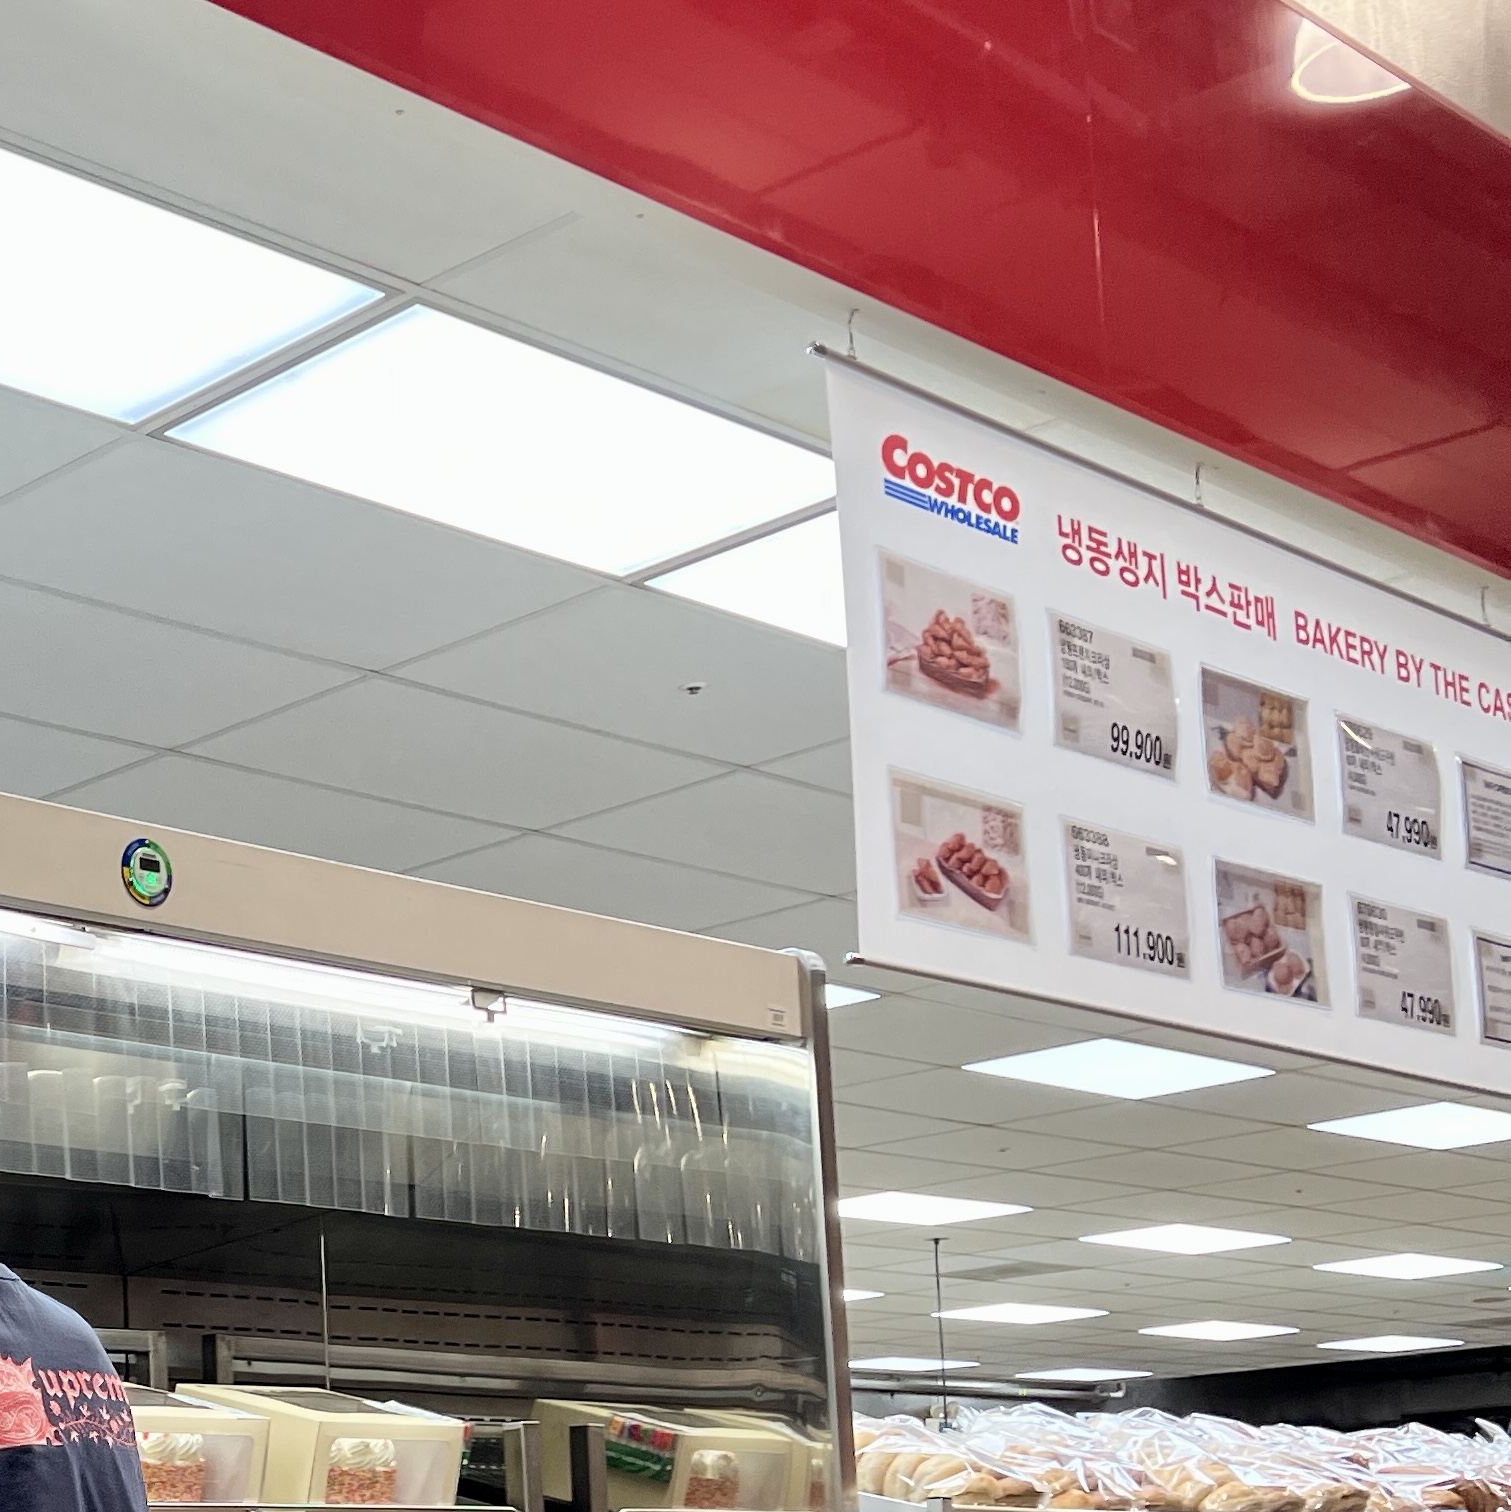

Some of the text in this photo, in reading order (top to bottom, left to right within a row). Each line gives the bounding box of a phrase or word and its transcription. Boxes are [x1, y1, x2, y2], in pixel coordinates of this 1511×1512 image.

[881, 434, 1021, 523] COSTCO
[927, 494, 1019, 545] WHOLESALE
[1057, 514, 1168, 601] 냉동생지
[1175, 560, 1278, 642] 박스판매
[1294, 609, 1388, 676] BAKERY
[1395, 648, 1424, 689] BY
[1429, 661, 1472, 707] THE
